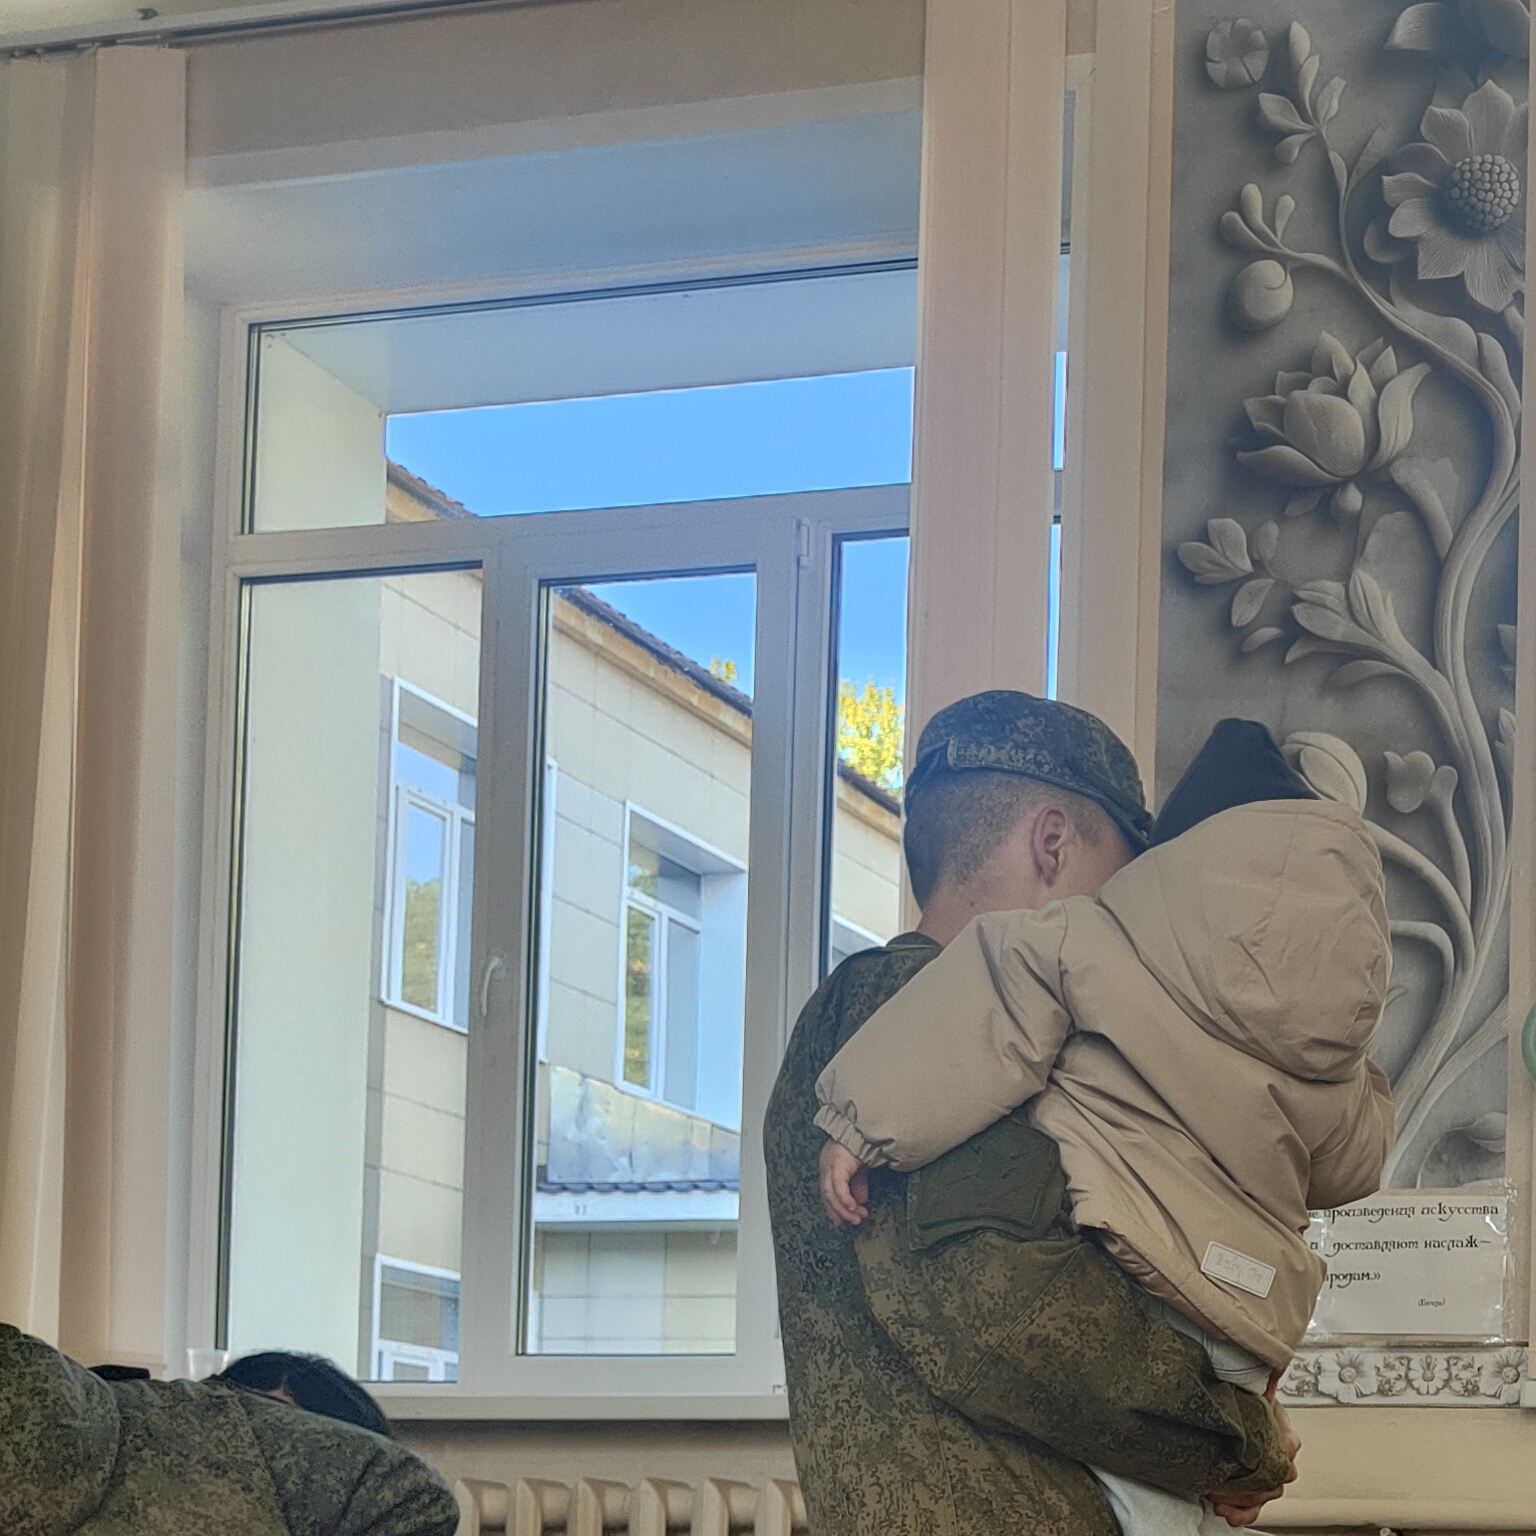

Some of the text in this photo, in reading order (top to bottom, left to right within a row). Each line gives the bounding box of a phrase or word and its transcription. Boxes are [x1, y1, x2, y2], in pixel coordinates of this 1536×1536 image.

[1323, 1206, 1416, 1226] произведения
[1420, 1202, 1499, 1222] искусства
[1324, 1240, 1420, 1258] доставляют
[1325, 1271, 1382, 1290] родам.»
